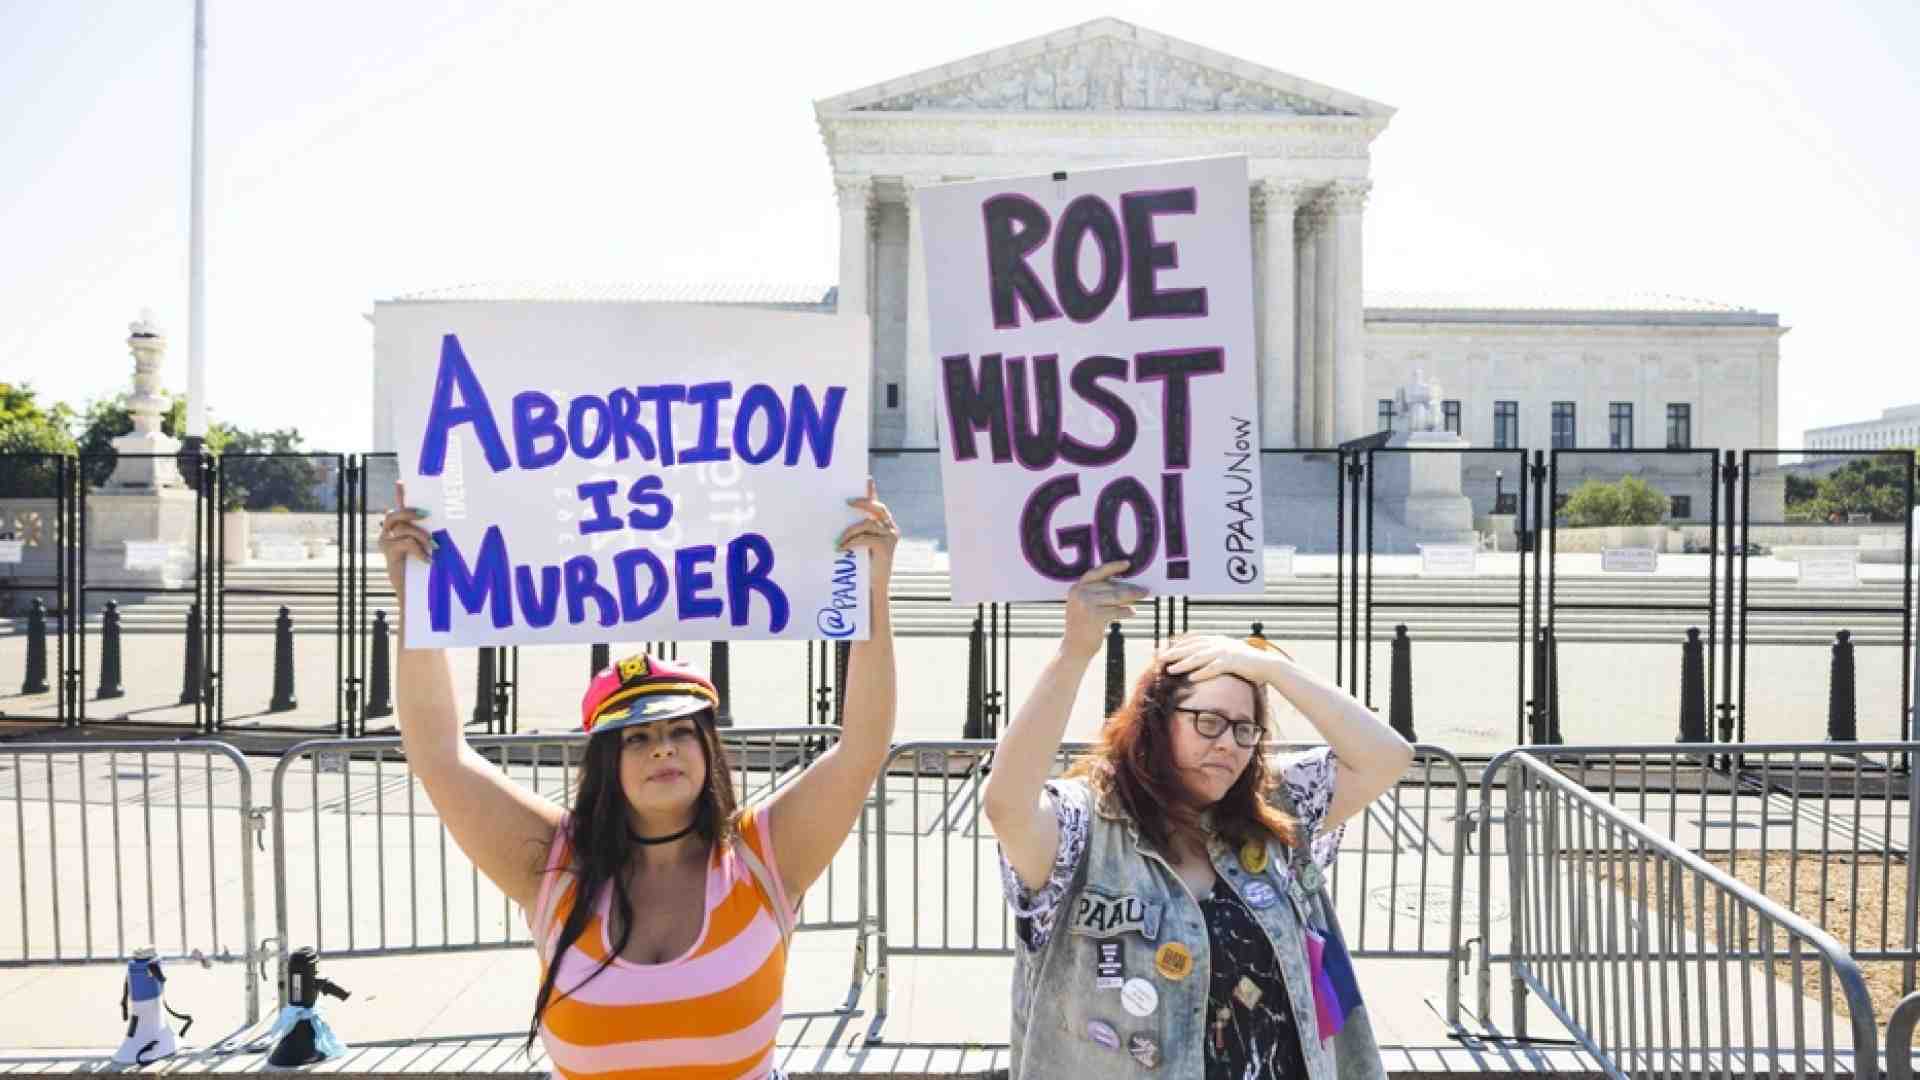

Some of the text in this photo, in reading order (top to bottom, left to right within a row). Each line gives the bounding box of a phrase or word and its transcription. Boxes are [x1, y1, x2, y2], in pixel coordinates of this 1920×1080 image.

[981, 187, 1209, 330] ROE
[418, 333, 847, 476] ABORTION
[941, 346, 1225, 472] MUST
[576, 474, 673, 535] IS
[1019, 473, 1190, 583] GO!
[428, 525, 790, 634] MURDER
[1076, 898, 1146, 931] PAAU
